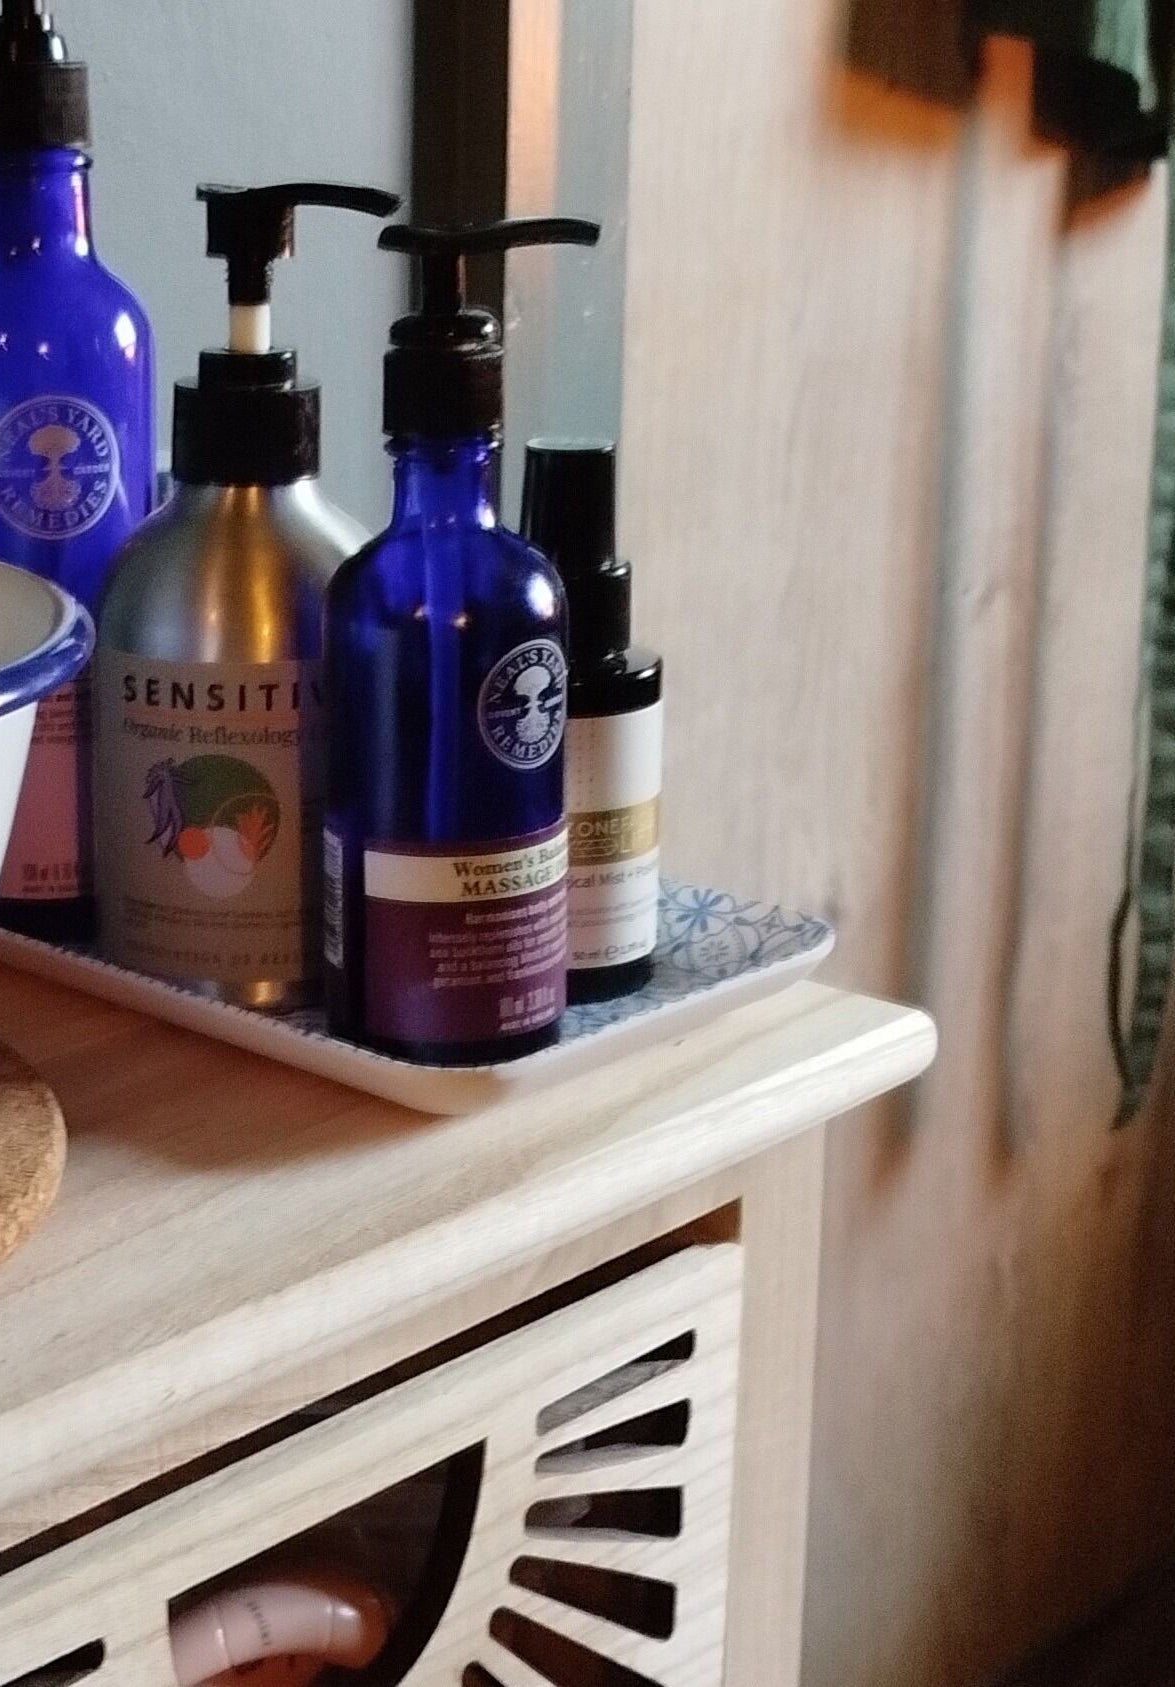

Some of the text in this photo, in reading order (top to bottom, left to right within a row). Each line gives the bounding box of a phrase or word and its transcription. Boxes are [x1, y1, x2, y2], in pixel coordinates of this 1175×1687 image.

[68, 408, 109, 457] YARD
[452, 854, 535, 878] Women's
[461, 866, 553, 897] MASSAGE
